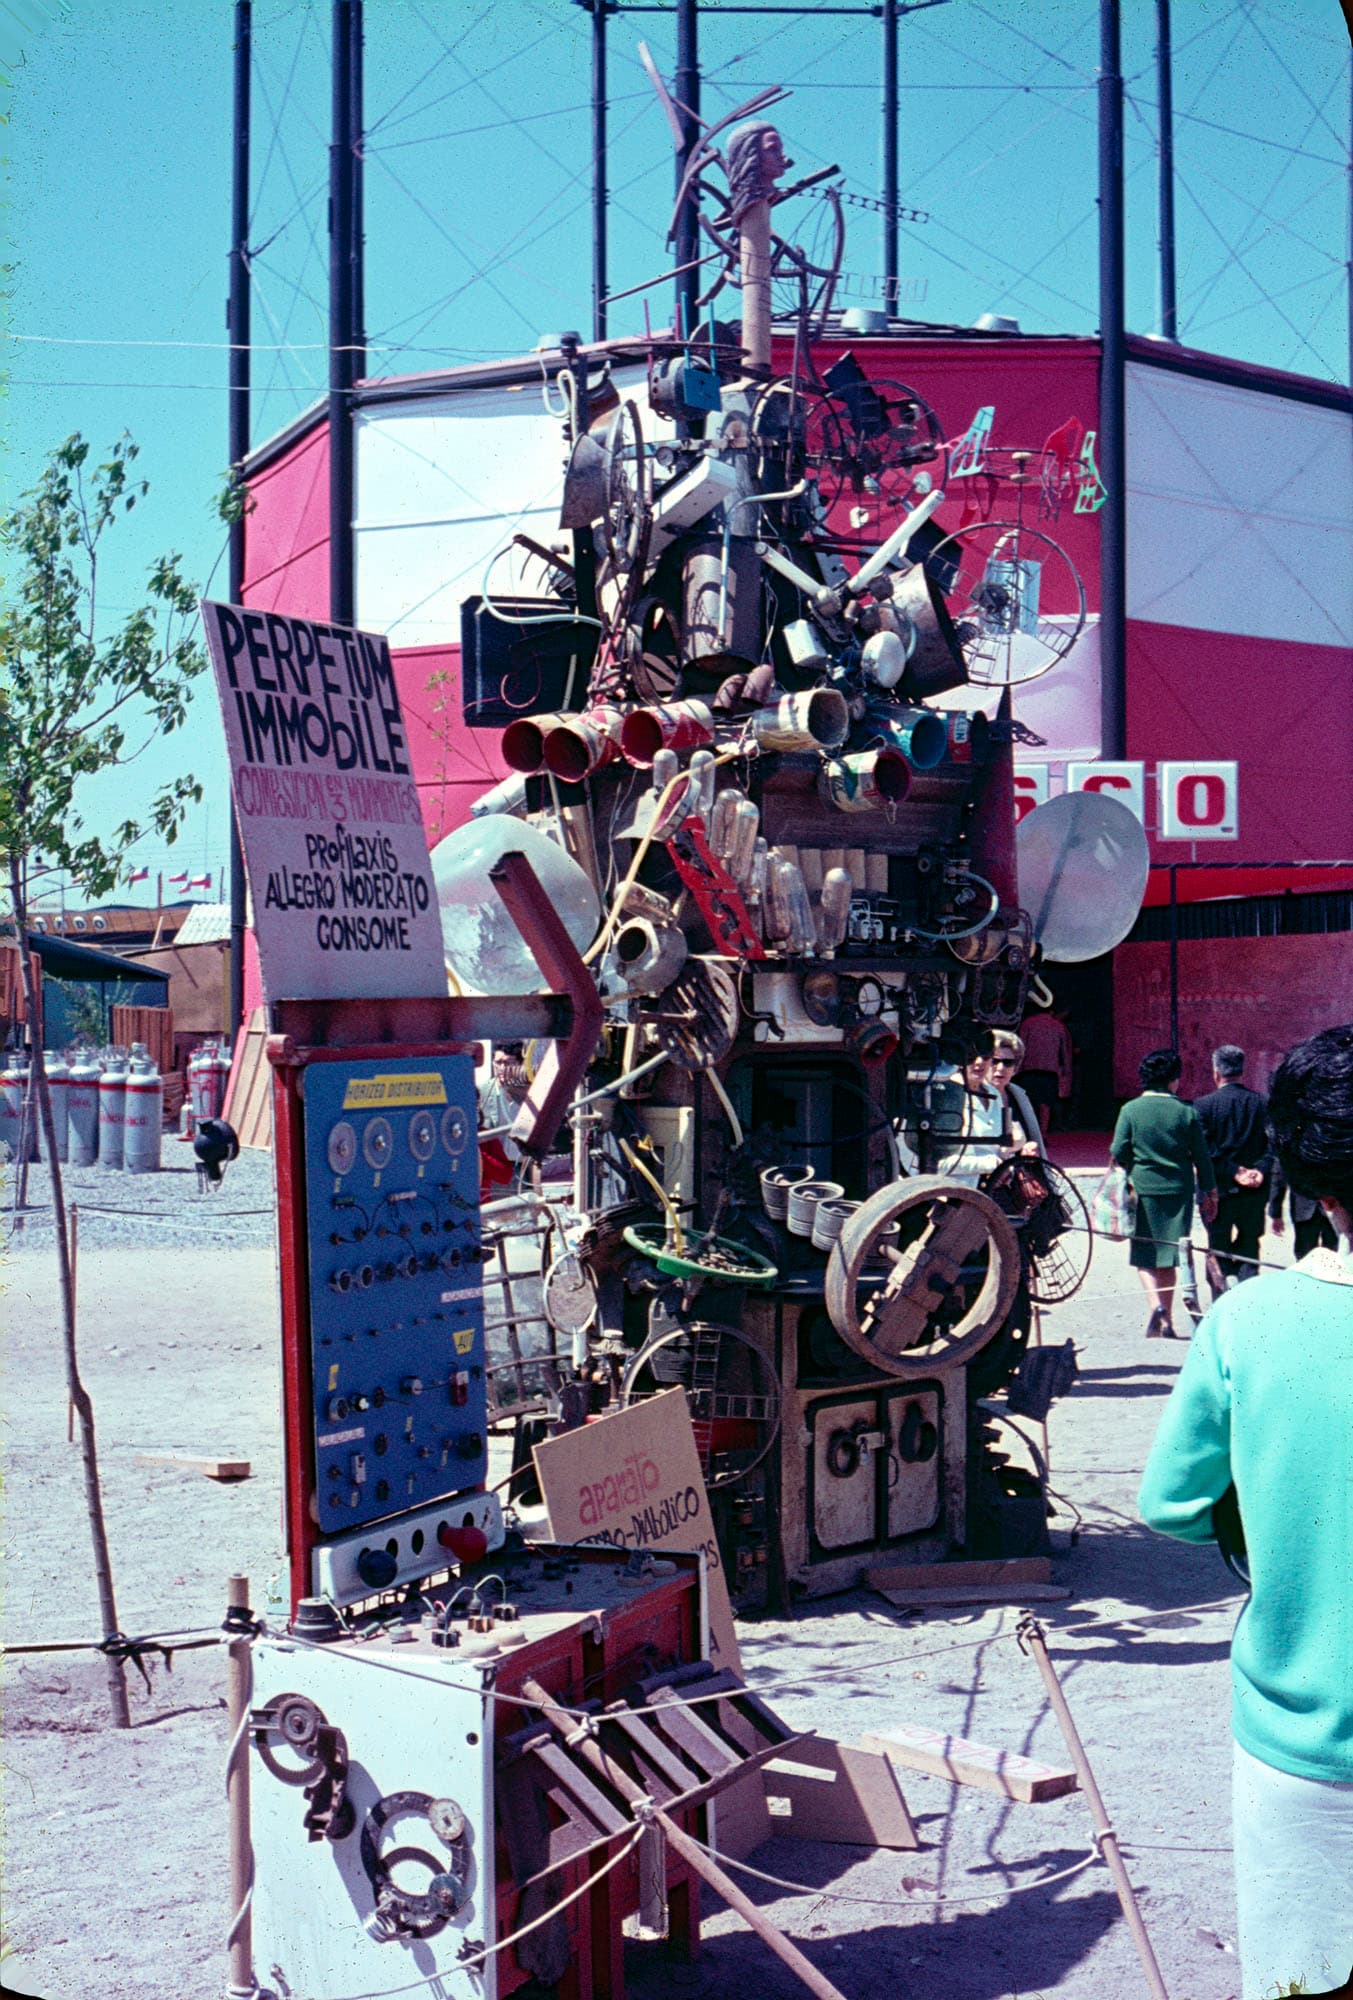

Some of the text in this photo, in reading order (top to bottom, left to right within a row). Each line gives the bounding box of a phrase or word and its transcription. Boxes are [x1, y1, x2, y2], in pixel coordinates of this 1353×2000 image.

[216, 605, 399, 709] PERPETUM
[265, 865, 430, 918] ALLEGRO MODERATO
